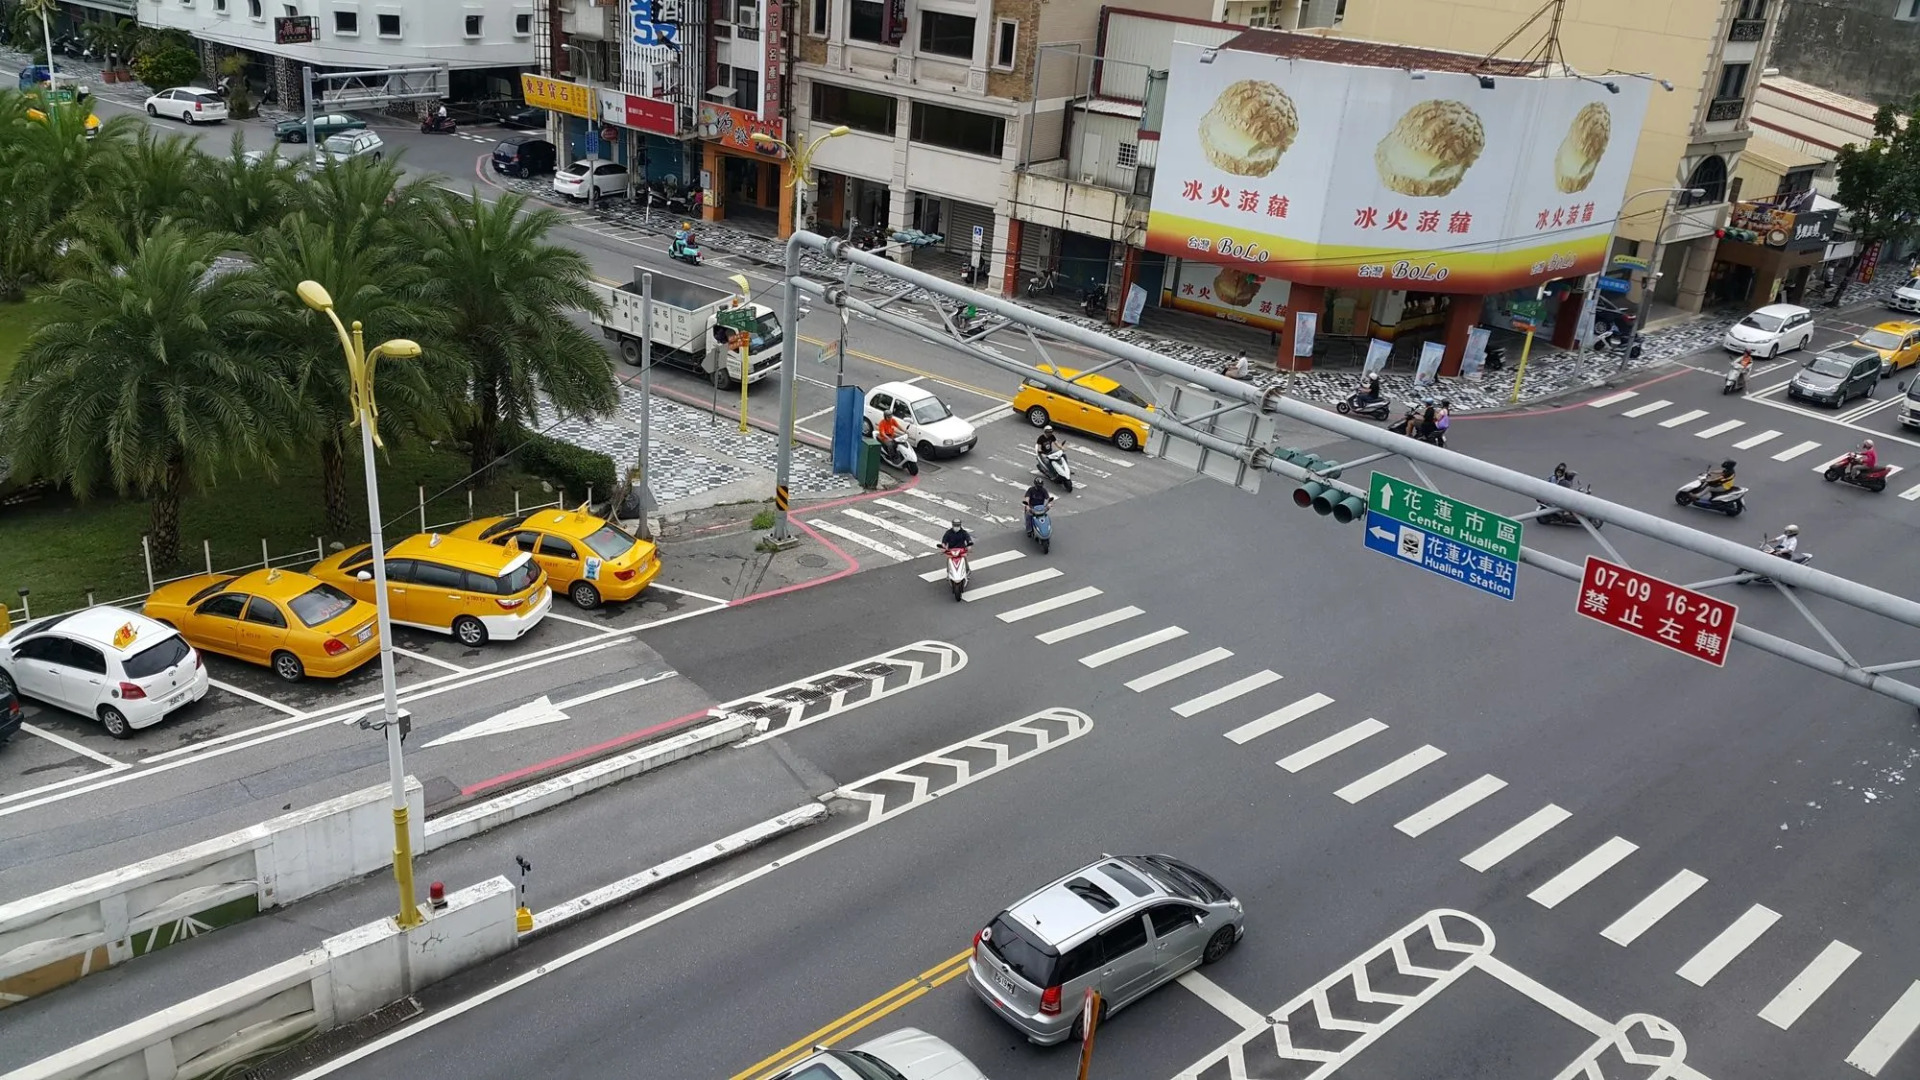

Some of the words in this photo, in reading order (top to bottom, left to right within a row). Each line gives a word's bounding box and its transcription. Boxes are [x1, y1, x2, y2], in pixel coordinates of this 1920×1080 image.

[1182, 179, 1290, 218] 冰火菠蘿
[1353, 206, 1473, 234] 冰火菠蘿
[1218, 236, 1270, 263] BoLo
[1391, 260, 1449, 281] BoLo
[1403, 488, 1518, 544] 花蓮市區
[1408, 511, 1454, 536] Central
[1459, 529, 1507, 555] Hualien
[1424, 556, 1464, 579] Hualien
[1469, 572, 1511, 596] Station
[1427, 536, 1513, 584] 花蓮火車站
[1594, 567, 1651, 602] 07-09
[1665, 591, 1722, 628] 16-20
[1583, 589, 1723, 657] 禁止左轉
